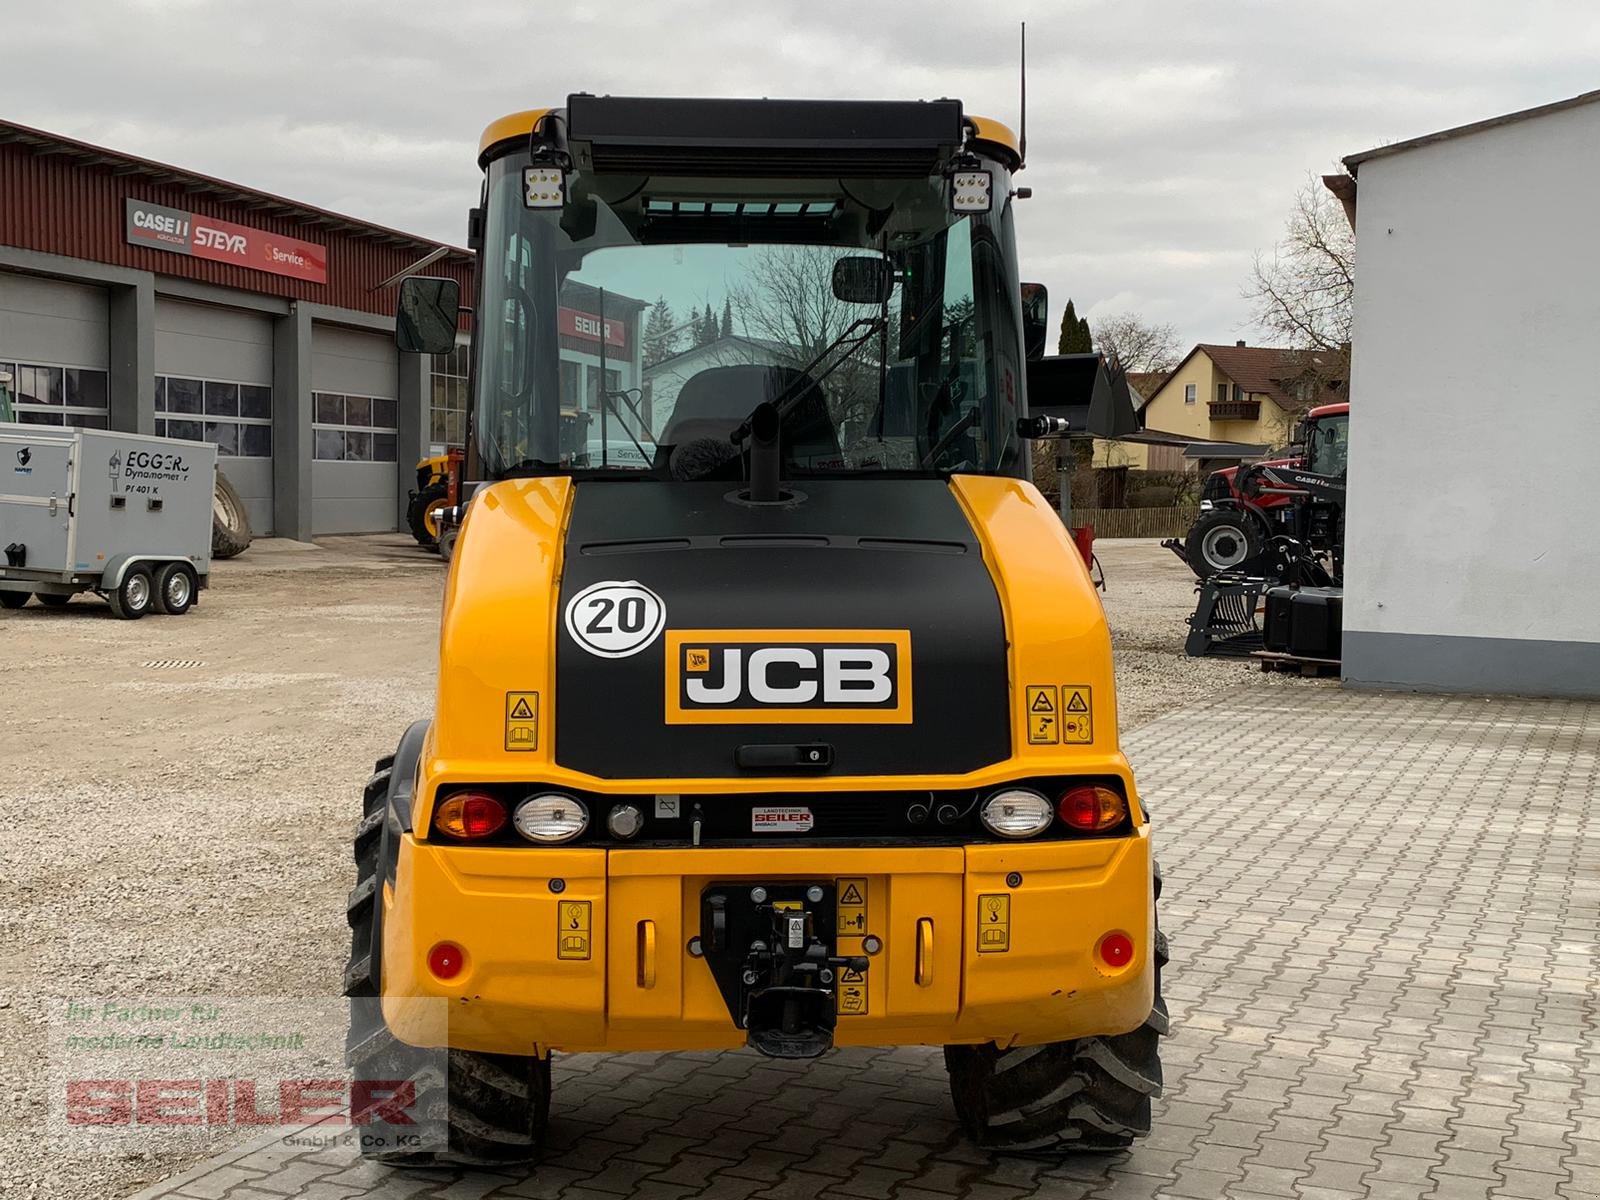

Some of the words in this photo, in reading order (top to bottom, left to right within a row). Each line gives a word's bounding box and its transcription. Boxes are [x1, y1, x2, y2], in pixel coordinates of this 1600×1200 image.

[193, 226, 247, 255] STEYR
[272, 247, 304, 266] Service
[586, 597, 646, 634] 20
[686, 648, 892, 704] JCB
[754, 813, 810, 822] SEILER
